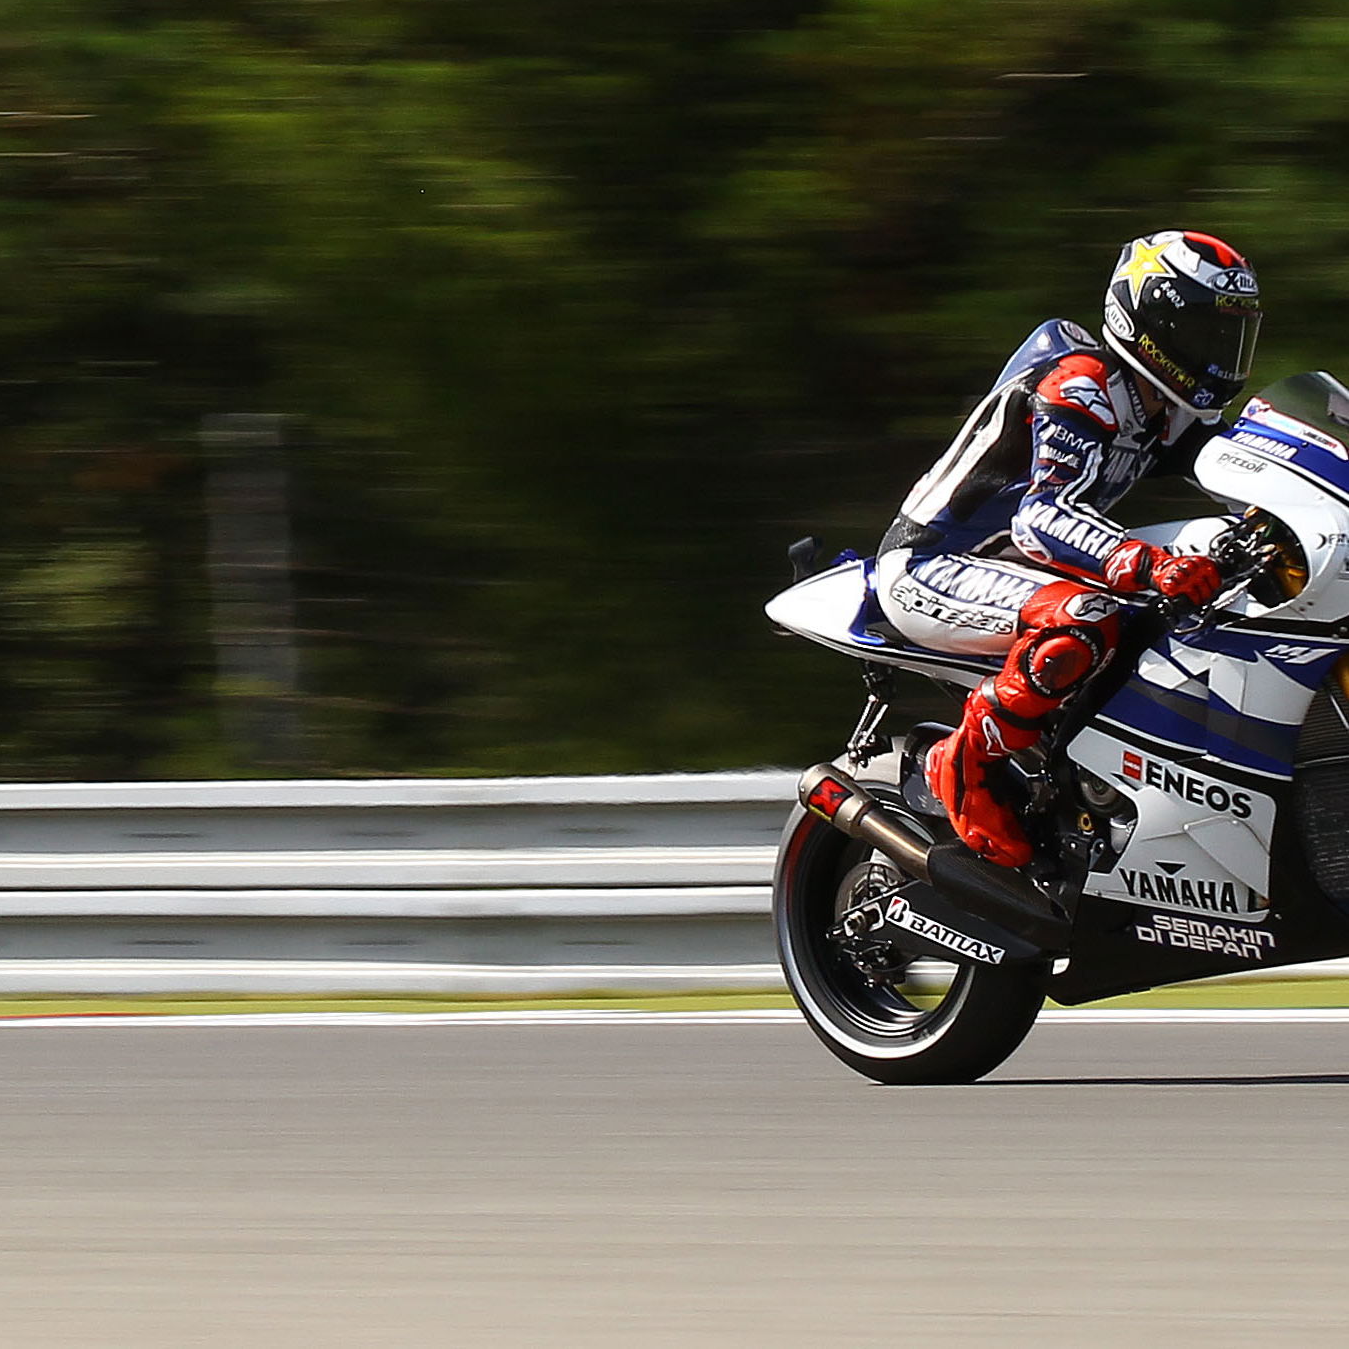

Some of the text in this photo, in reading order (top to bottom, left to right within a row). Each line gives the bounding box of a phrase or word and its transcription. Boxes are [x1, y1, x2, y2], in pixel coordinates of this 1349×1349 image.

[1231, 431, 1298, 460] YAMAHA
[890, 585, 1014, 635] alpinestars
[1146, 759, 1252, 819] ENEOS
[1118, 867, 1239, 914] YAMAHA
[909, 913, 1002, 964] BATTLAX
[1135, 925, 1263, 961] DI DEPAN
[1152, 914, 1276, 948] SEMAKIN
